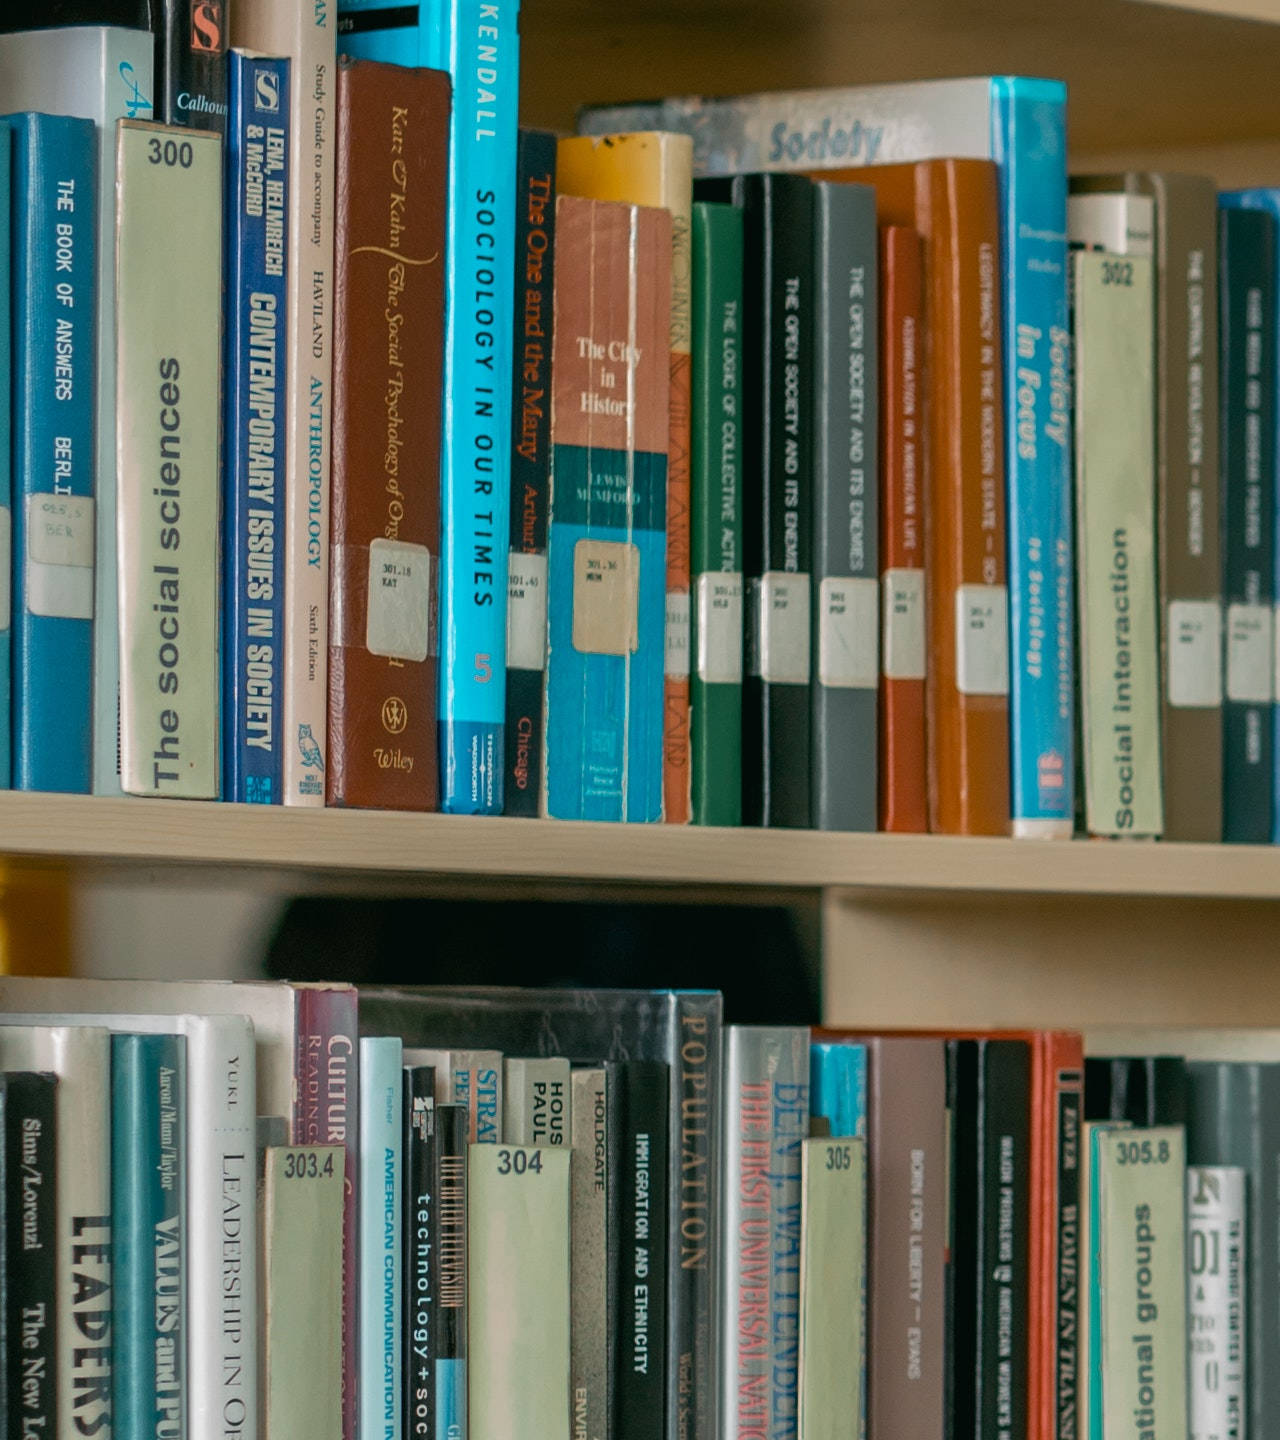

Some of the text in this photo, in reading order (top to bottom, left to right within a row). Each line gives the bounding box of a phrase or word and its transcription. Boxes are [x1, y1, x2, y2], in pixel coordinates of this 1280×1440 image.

[476, 4, 499, 142] KENDALL
[147, 139, 194, 168] 300
[766, 120, 884, 166] Society
[55, 180, 75, 401] THE BOOK OF ANSWERS
[309, 270, 326, 360] HAVILAND
[1101, 264, 1133, 286] 302
[472, 190, 496, 608] SOCIOLOGY IN OUR TIMES
[306, 375, 322, 568] ANTHROPOLOGY
[245, 293, 276, 750] CONTEMPORARY ISSUES IN SOCIETY
[152, 357, 182, 789] The social sciences
[1109, 528, 1134, 830] Social interaction
[372, 746, 414, 772] Wiley
[226, 1056, 243, 1112] YUKL
[283, 1152, 335, 1179] 303.4
[496, 1151, 544, 1176] 304
[825, 1147, 851, 1171] 305
[1115, 1139, 1171, 1166] 305.8
[221, 1151, 252, 1344] LEADERSHIP
[633, 1133, 649, 1374] IMMIGRATION AND ETHNICITY
[1135, 1204, 1158, 1327] groups
[221, 1353, 243, 1386] IN
